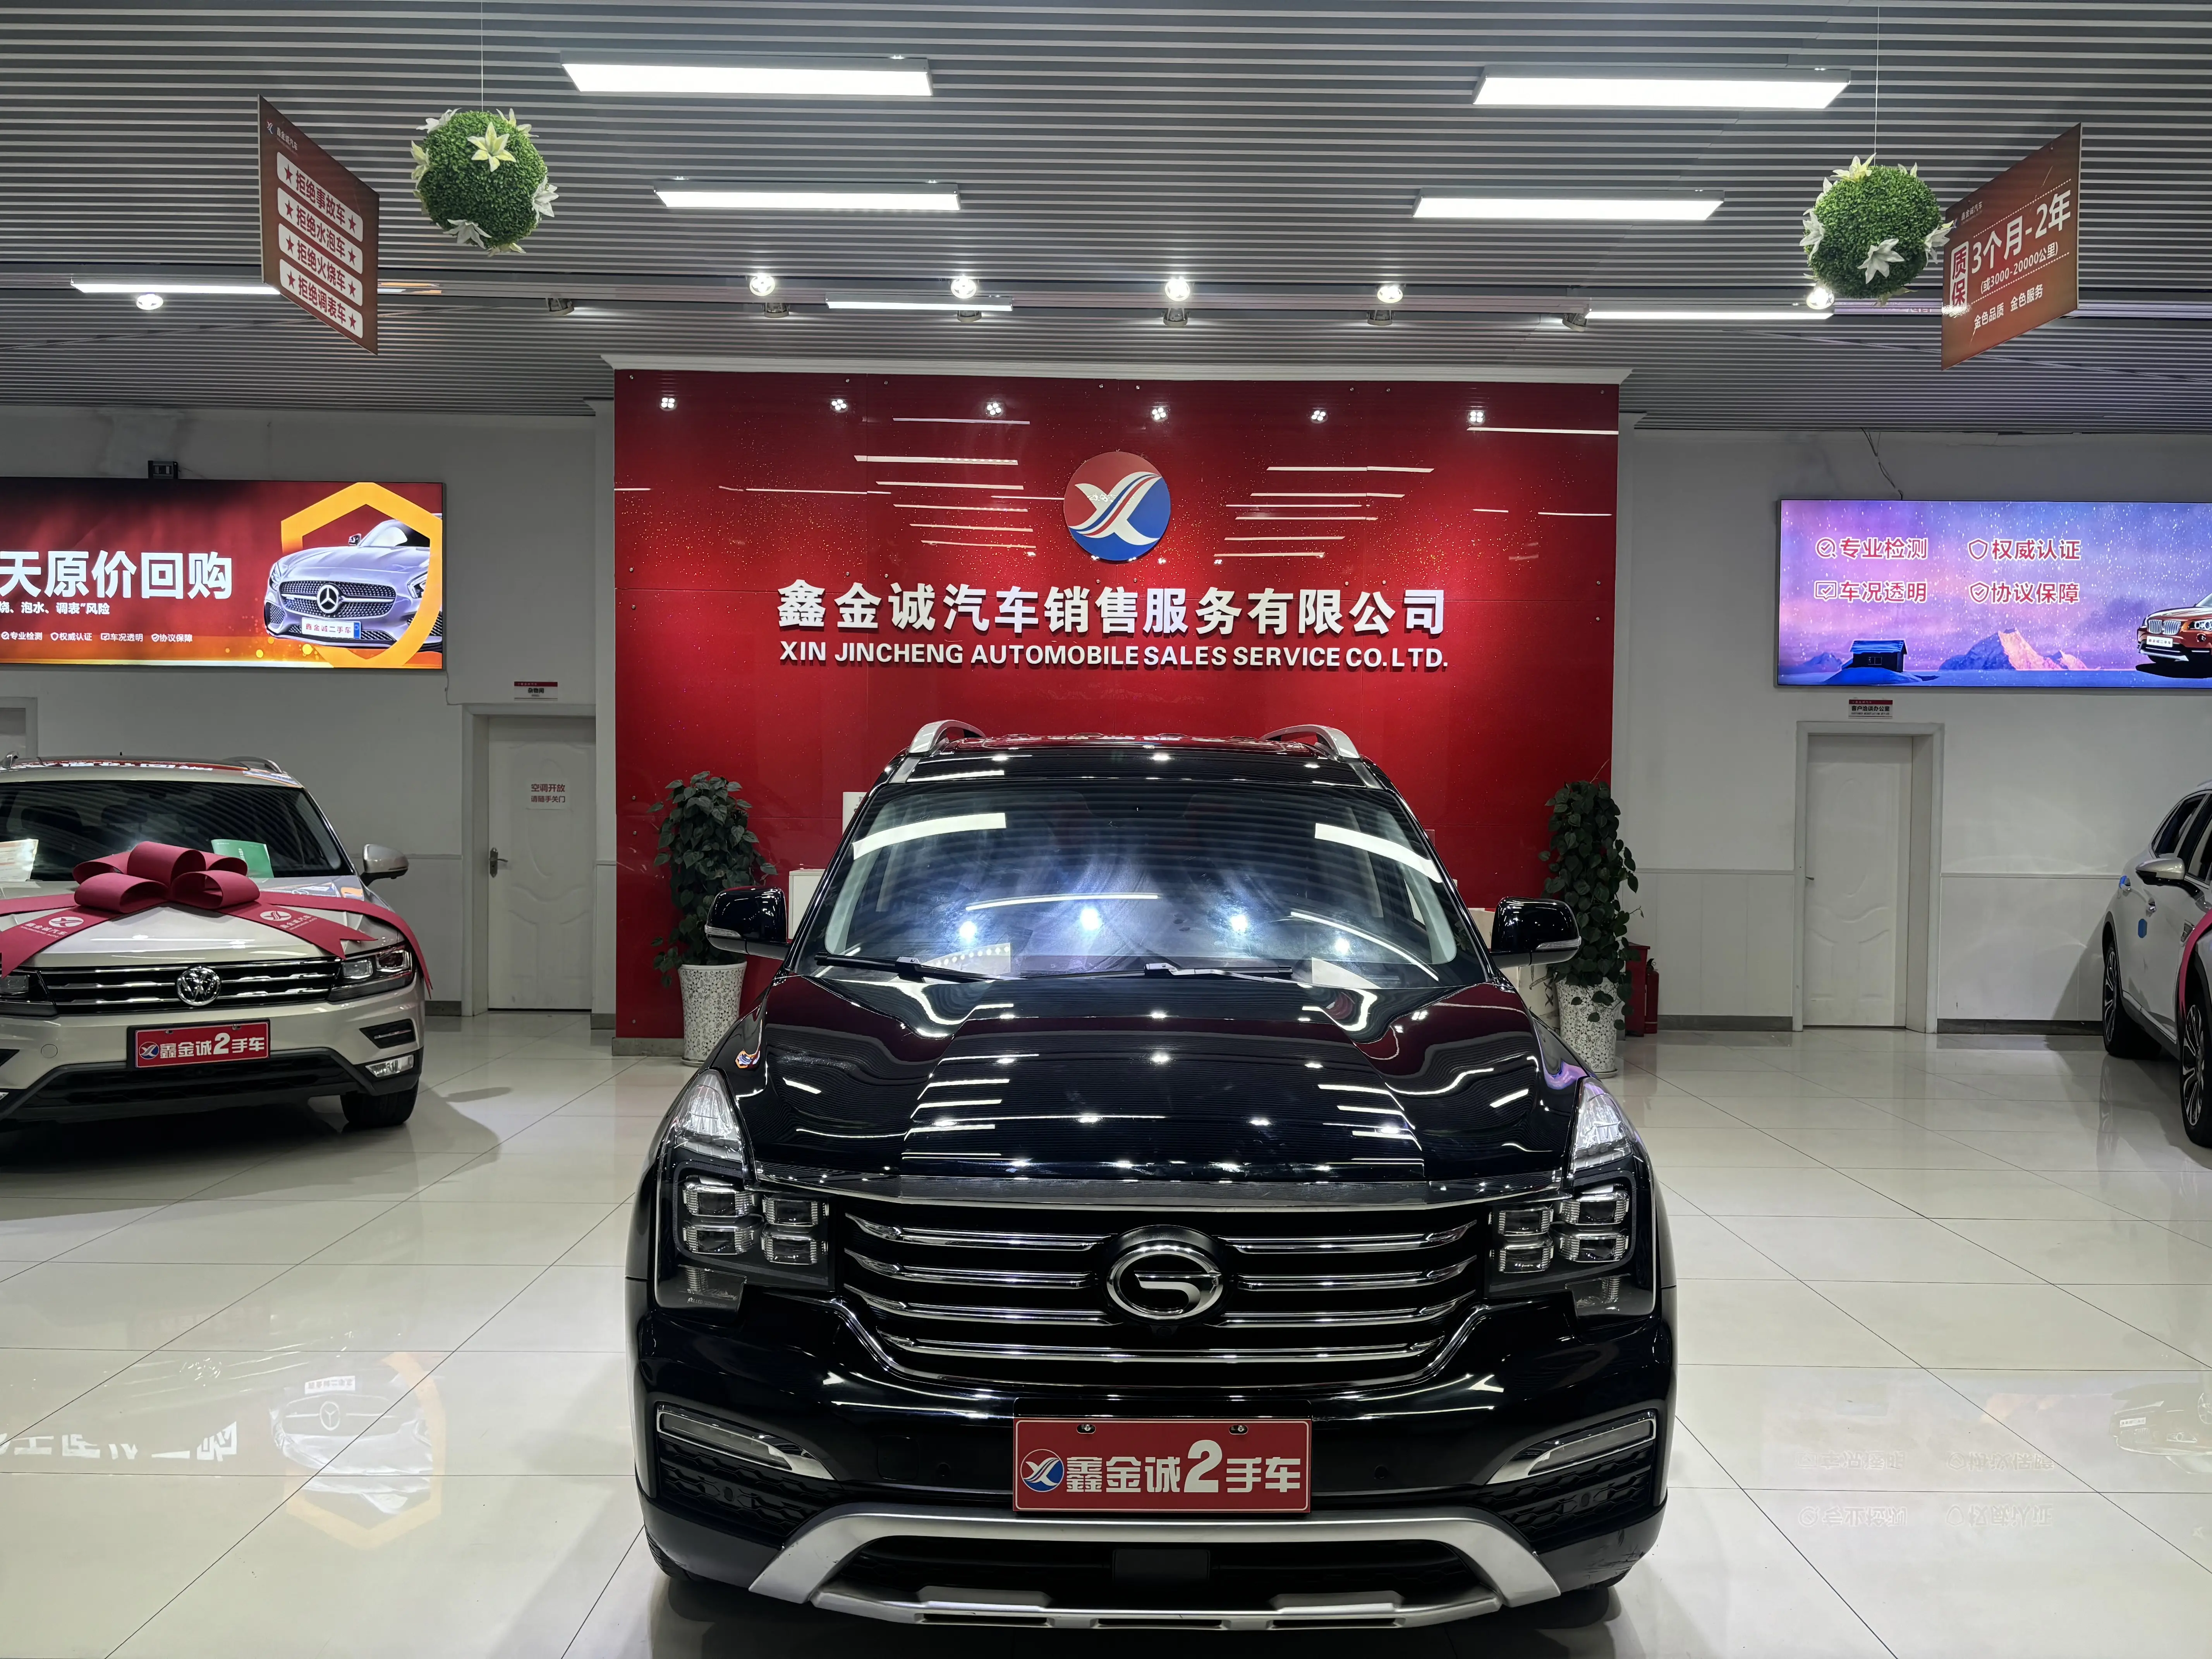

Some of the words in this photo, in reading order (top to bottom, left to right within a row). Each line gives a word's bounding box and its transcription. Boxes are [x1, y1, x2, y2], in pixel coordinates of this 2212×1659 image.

[295, 170, 346, 225] 拒绝事故车
[296, 205, 345, 258] 拒绝水泡车
[1972, 189, 2071, 273] 3个月-2年
[297, 240, 345, 291] 拒绝火烧车
[1952, 247, 1967, 306] 质保
[1980, 241, 2058, 294] (或3000-20000公里)
[298, 275, 346, 324] 拒绝调表车
[1974, 302, 2004, 330] 金色品质
[2010, 284, 2043, 312] 金色服务
[1840, 538, 1927, 559] 专业检测
[1992, 539, 2081, 560] 权威认证
[0, 550, 232, 599] 天原价回购
[1839, 581, 1927, 603] 车况透明
[1990, 582, 2080, 604] 协议保障
[778, 579, 1444, 635] 鑫金诚汽车销售服务有限公司
[10, 632, 43, 641] 专业检测
[59, 632, 92, 641] 权威认证
[110, 633, 143, 642] 车况透明
[160, 634, 193, 643] 协议保障
[780, 641, 826, 662] XIN
[835, 642, 963, 663] JINCHENG
[970, 644, 1139, 665] AUTOMOBILE
[1144, 646, 1226, 666] SALES
[1233, 646, 1340, 667] SERVICE
[531, 783, 565, 792] 空调开放
[160, 1032, 265, 1059] 鑫金诚2手车
[1066, 1439, 1301, 1493] 鑫金诚2手车
